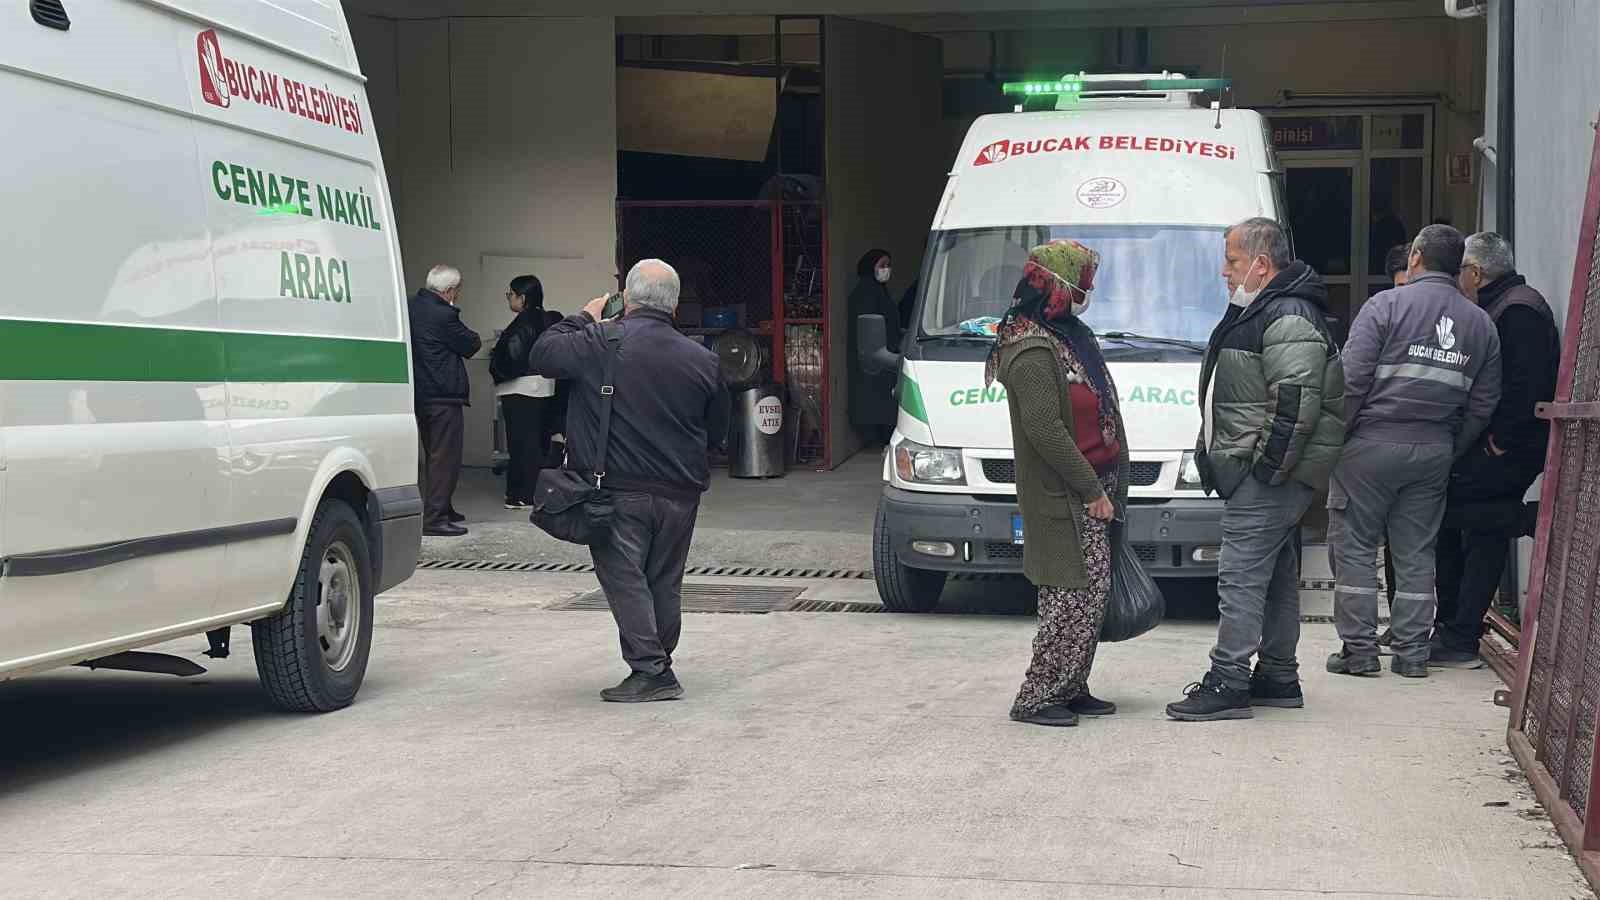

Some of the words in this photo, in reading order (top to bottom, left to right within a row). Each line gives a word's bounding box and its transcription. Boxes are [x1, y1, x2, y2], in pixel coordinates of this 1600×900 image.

[224, 58, 284, 111] BUCAK
[283, 78, 364, 135] BELEDİYESİ
[1011, 136, 1089, 156] BUCAK
[212, 160, 313, 217] CENAZE
[317, 184, 381, 231] NAKİL
[280, 251, 352, 303] ARACI
[1408, 344, 1434, 359] BUCAK
[1128, 385, 1196, 406] ARAC
